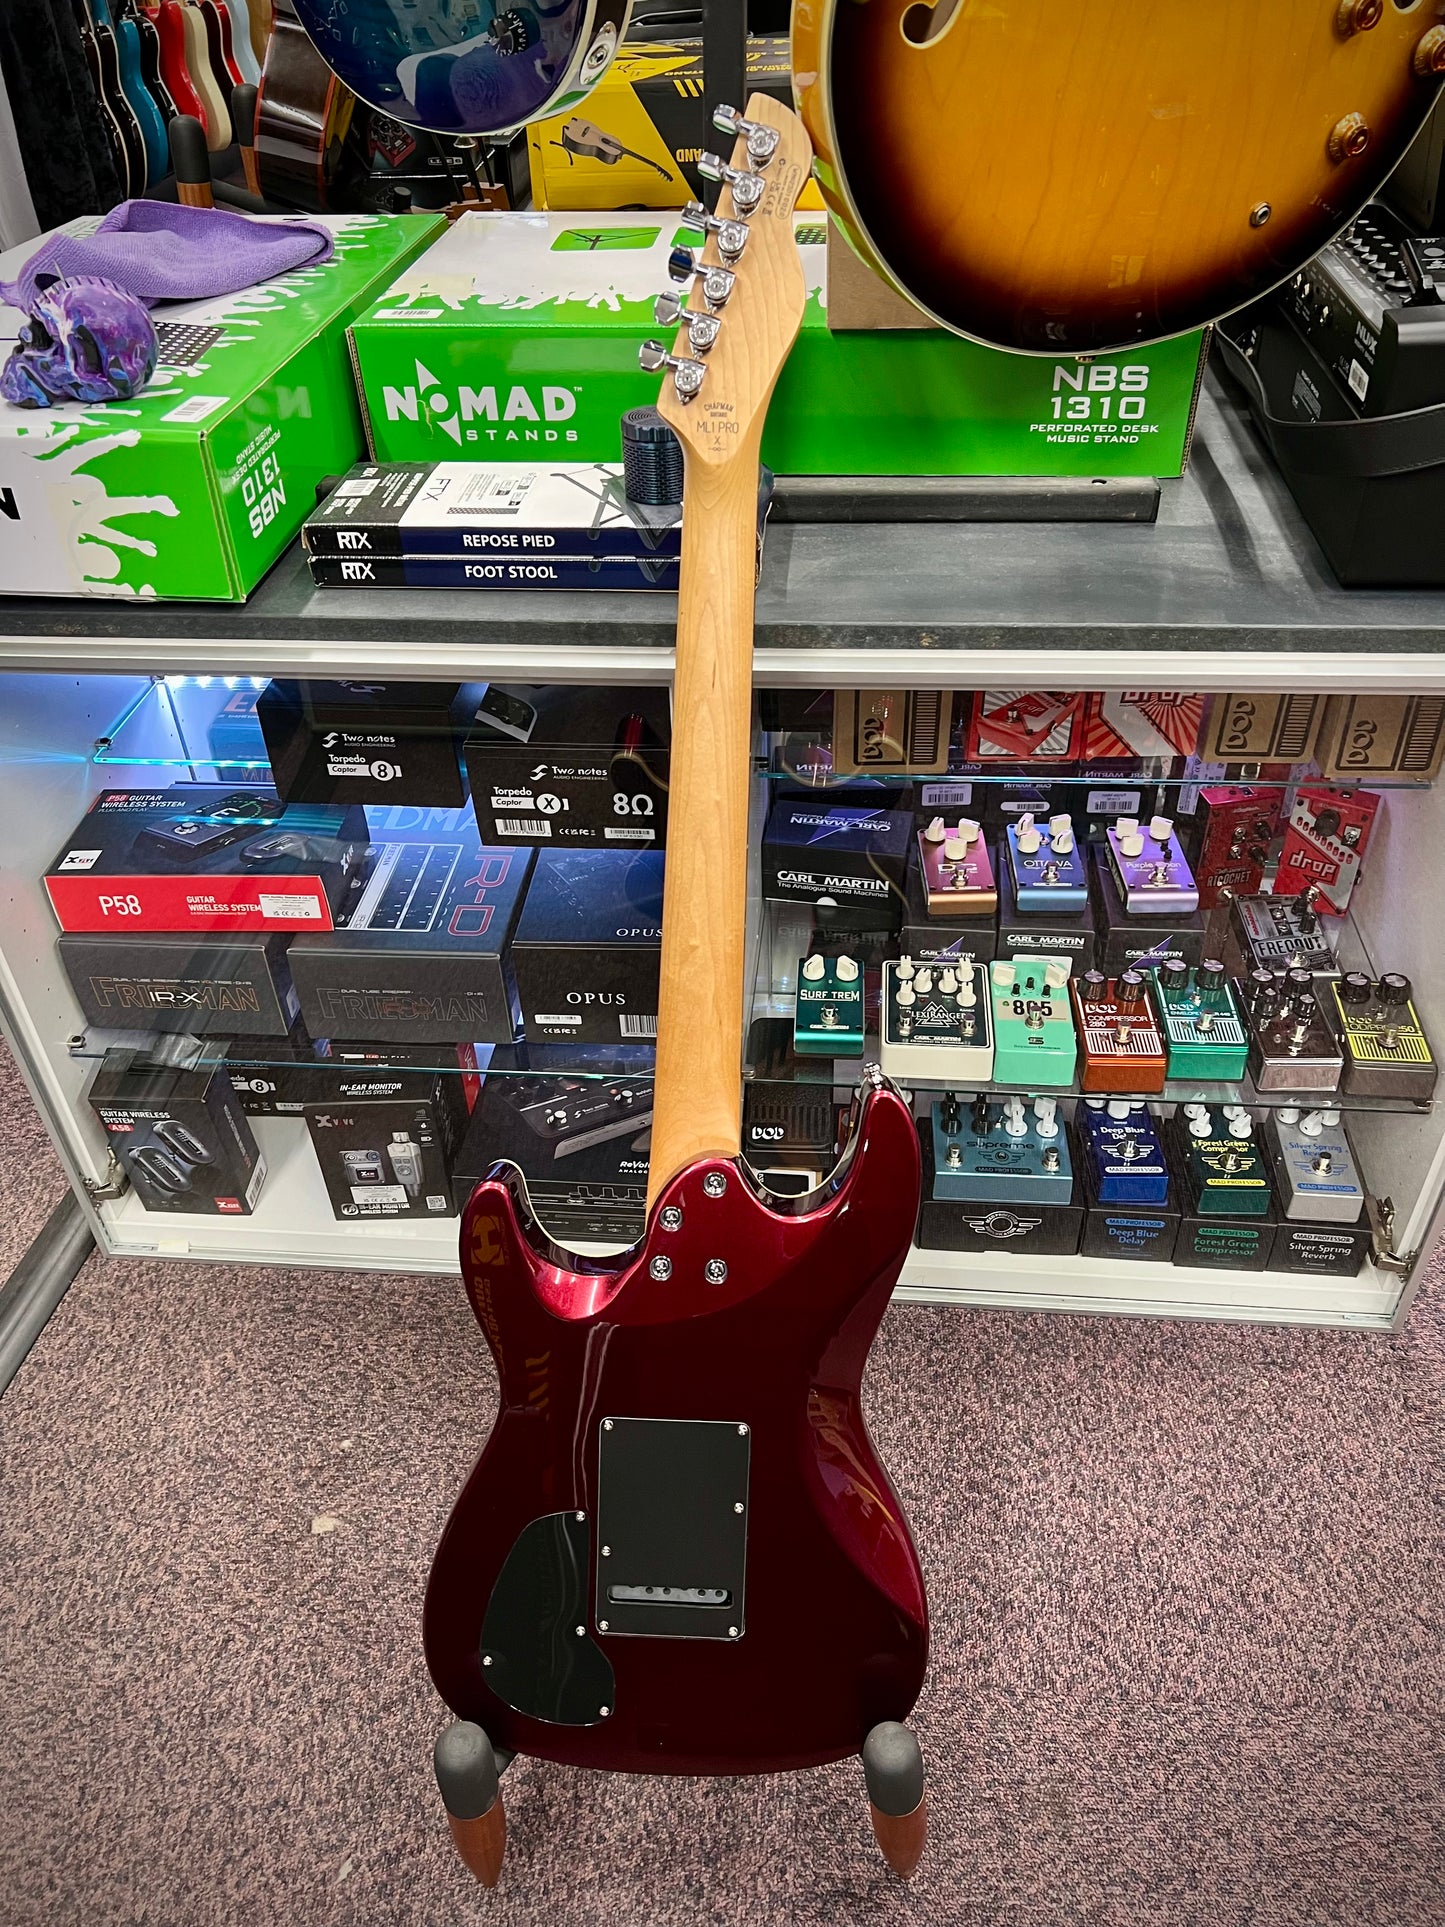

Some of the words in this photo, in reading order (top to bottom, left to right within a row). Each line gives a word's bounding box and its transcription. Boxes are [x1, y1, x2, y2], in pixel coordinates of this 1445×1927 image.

[676, 148, 704, 162] AND
[1356, 321, 1378, 354] NUX
[1052, 365, 1150, 392] NBS
[1050, 396, 1146, 420] 1310
[718, 421, 740, 434] PRO
[1030, 424, 1117, 433] PERFORATED
[1121, 425, 1159, 434] DESK
[466, 429, 578, 441] STANDS
[1046, 434, 1090, 443] MUSIC
[1094, 434, 1139, 444] STAND
[242, 451, 280, 507] 1310
[421, 478, 451, 501] FTX
[249, 479, 286, 538] NBS
[336, 531, 372, 549] RTX
[463, 534, 518, 547] REPOSE
[522, 534, 555, 548] PIED
[340, 562, 376, 580] RTX
[464, 566, 504, 578] FOOT
[506, 565, 558, 579] STOOL
[343, 733, 363, 742] Two
[367, 735, 395, 743] notes
[328, 754, 366, 764] Torpedo
[332, 766, 357, 774] Captor
[377, 763, 388, 778] 8
[552, 766, 575, 775] Two
[578, 767, 608, 776] notes
[493, 786, 532, 797] Torpedo
[496, 798, 522, 807] Captor
[543, 797, 555, 810] X
[613, 793, 654, 815] 8Ω
[790, 816, 848, 828] MARTIN
[858, 821, 891, 832] CARL
[1289, 851, 1336, 880] drop
[777, 870, 817, 884] CARL
[824, 877, 889, 891] MARTIN
[1207, 872, 1251, 887] RICOCHET
[792, 883, 826, 893] Analogue
[829, 887, 852, 895] Sound
[854, 889, 888, 898] Machines
[98, 894, 142, 916] P58
[186, 895, 215, 904] GUITAR
[188, 904, 229, 912] WIRELESS
[231, 904, 262, 912] SYSTEM
[616, 928, 663, 937] OPUS
[1007, 934, 1035, 943] CARL
[1039, 936, 1085, 945] MARTIN
[942, 951, 976, 959] MARTIN
[89, 977, 260, 1012] FRIEDMAN
[150, 991, 202, 1003] IR-X
[566, 992, 626, 1005] OPUS
[800, 989, 828, 999] SURF
[830, 991, 859, 1001] TREM
[316, 988, 488, 1022] FRIEDMAN
[1085, 1003, 1117, 1014] DOD
[255, 1082, 264, 1092] 8
[340, 1083, 367, 1091] IN-EAR
[368, 1082, 402, 1090] MONITOR
[131, 1111, 171, 1119] WIRELESS
[752, 1126, 784, 1140] DOD
[1100, 1127, 1124, 1135] Deep
[1125, 1126, 1145, 1134] Blue
[966, 1141, 1035, 1149] supreme
[1198, 1139, 1223, 1147] Forest
[1313, 1143, 1342, 1153] Spring
[1109, 1228, 1134, 1238] Deep
[1136, 1230, 1159, 1238] Blue
[1118, 1236, 1146, 1246] Delay
[1194, 1238, 1225, 1247] Forest
[1227, 1239, 1259, 1249] Green
[1194, 1246, 1255, 1256] Compressor
[1289, 1242, 1316, 1251] Silver
[1318, 1244, 1352, 1256] Spring
[1301, 1251, 1336, 1260] Reverb
